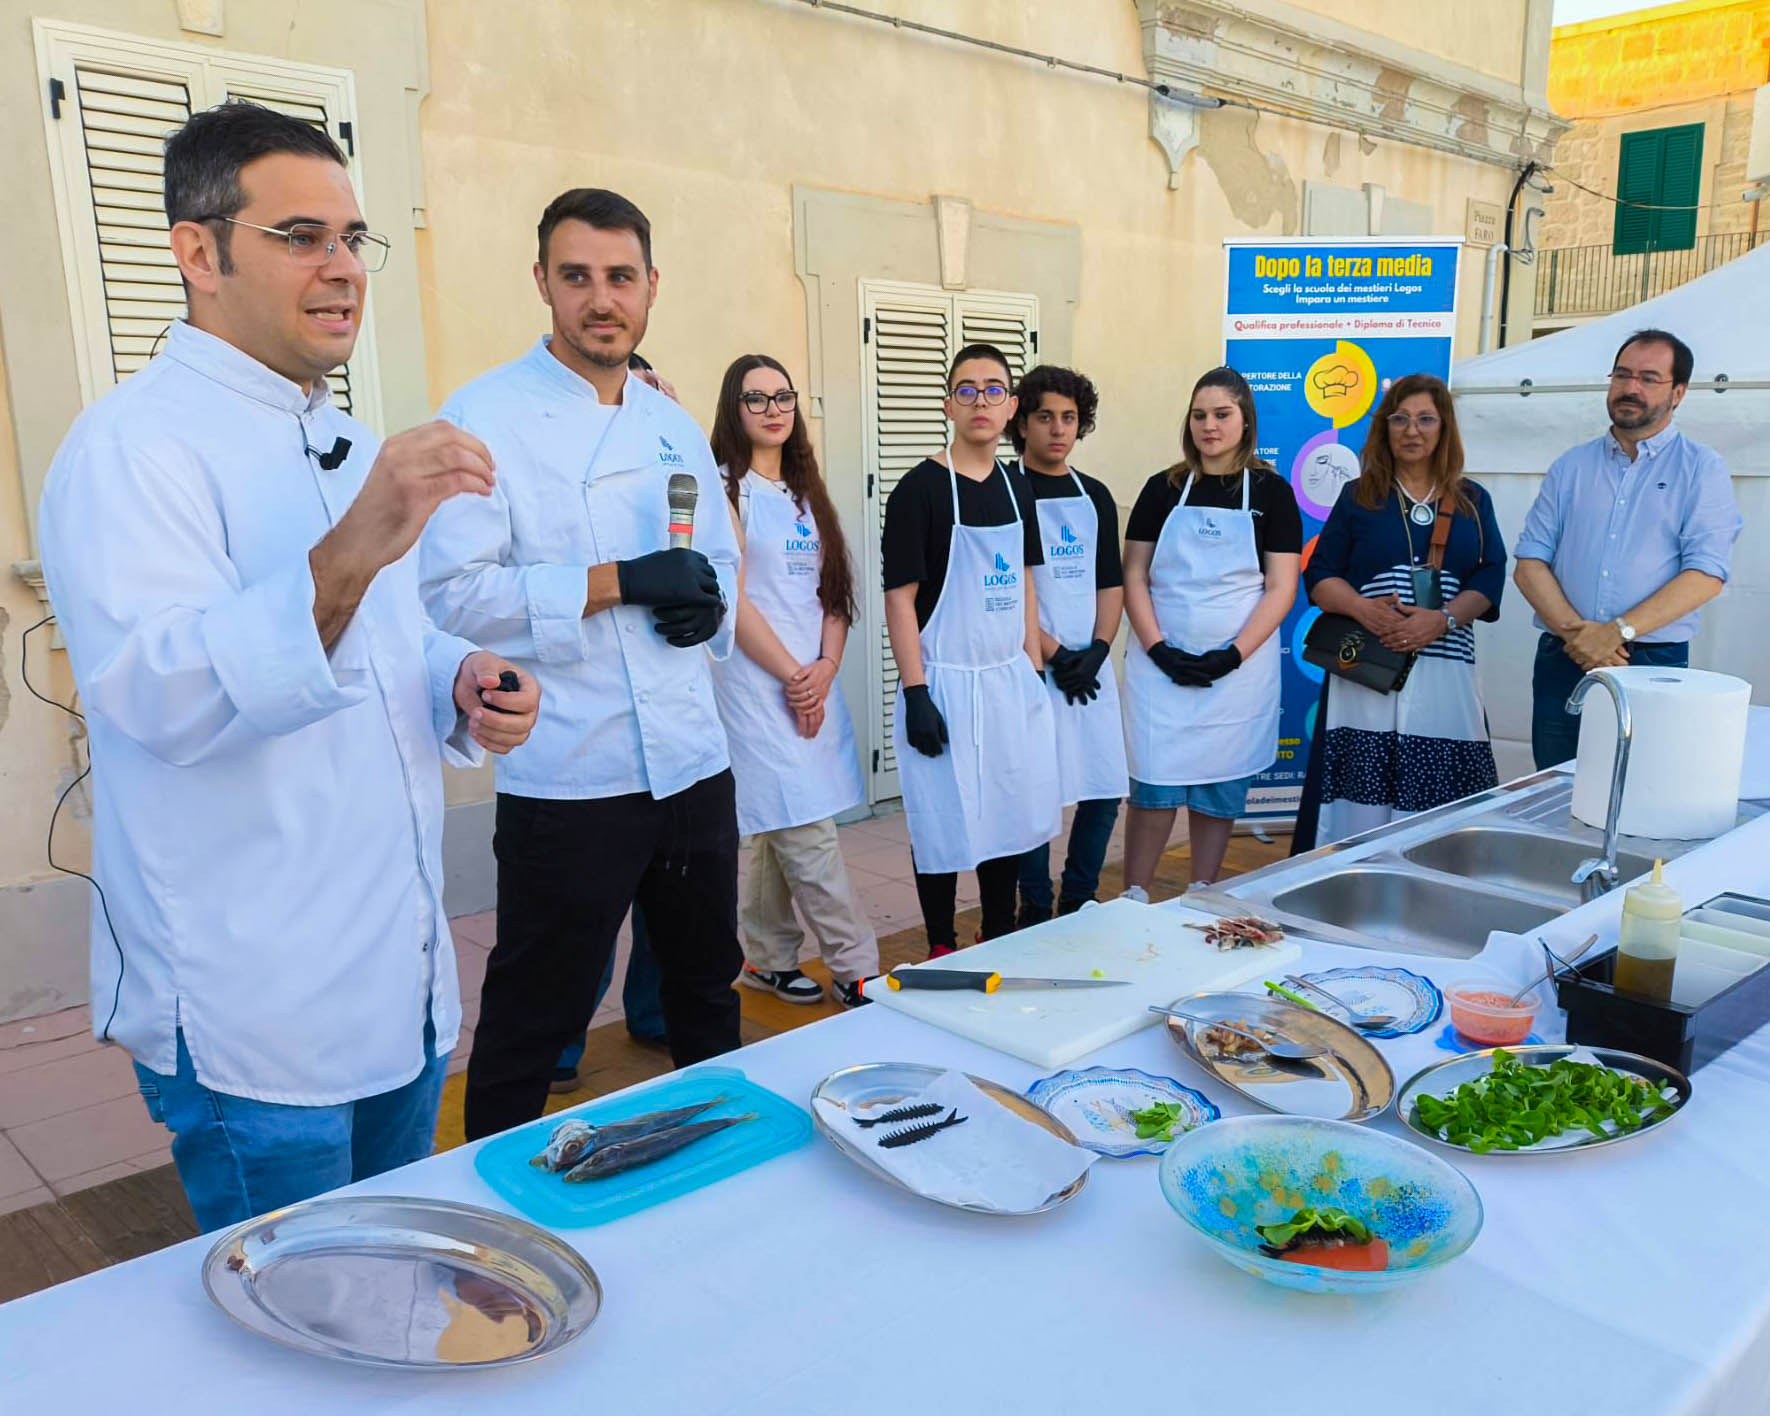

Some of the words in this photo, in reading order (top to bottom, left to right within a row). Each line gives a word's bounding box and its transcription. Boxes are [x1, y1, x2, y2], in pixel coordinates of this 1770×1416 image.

[1255, 254, 1300, 281] Dopo
[1305, 255, 1322, 278] la
[1327, 255, 1372, 277] terza
[1376, 254, 1432, 277] media
[1262, 283, 1291, 296] Scegli
[1293, 283, 1303, 293] la
[1305, 283, 1335, 293] scuola
[1337, 283, 1352, 293] dei
[1354, 283, 1393, 293] mestieri
[1394, 282, 1422, 294] Logos
[1295, 294, 1331, 306] Impara
[1347, 294, 1389, 303] mestiere
[1234, 320, 1277, 331] Qualifica
[1279, 319, 1343, 331] professionale
[1354, 320, 1393, 330] Diploma
[1395, 319, 1405, 329] di
[1408, 319, 1442, 328] Tecnico
[1278, 371, 1302, 380] DELLA
[1249, 383, 1292, 391] TORAZIONE
[786, 539, 820, 551] LOGOS
[1051, 544, 1085, 557] LOGOS
